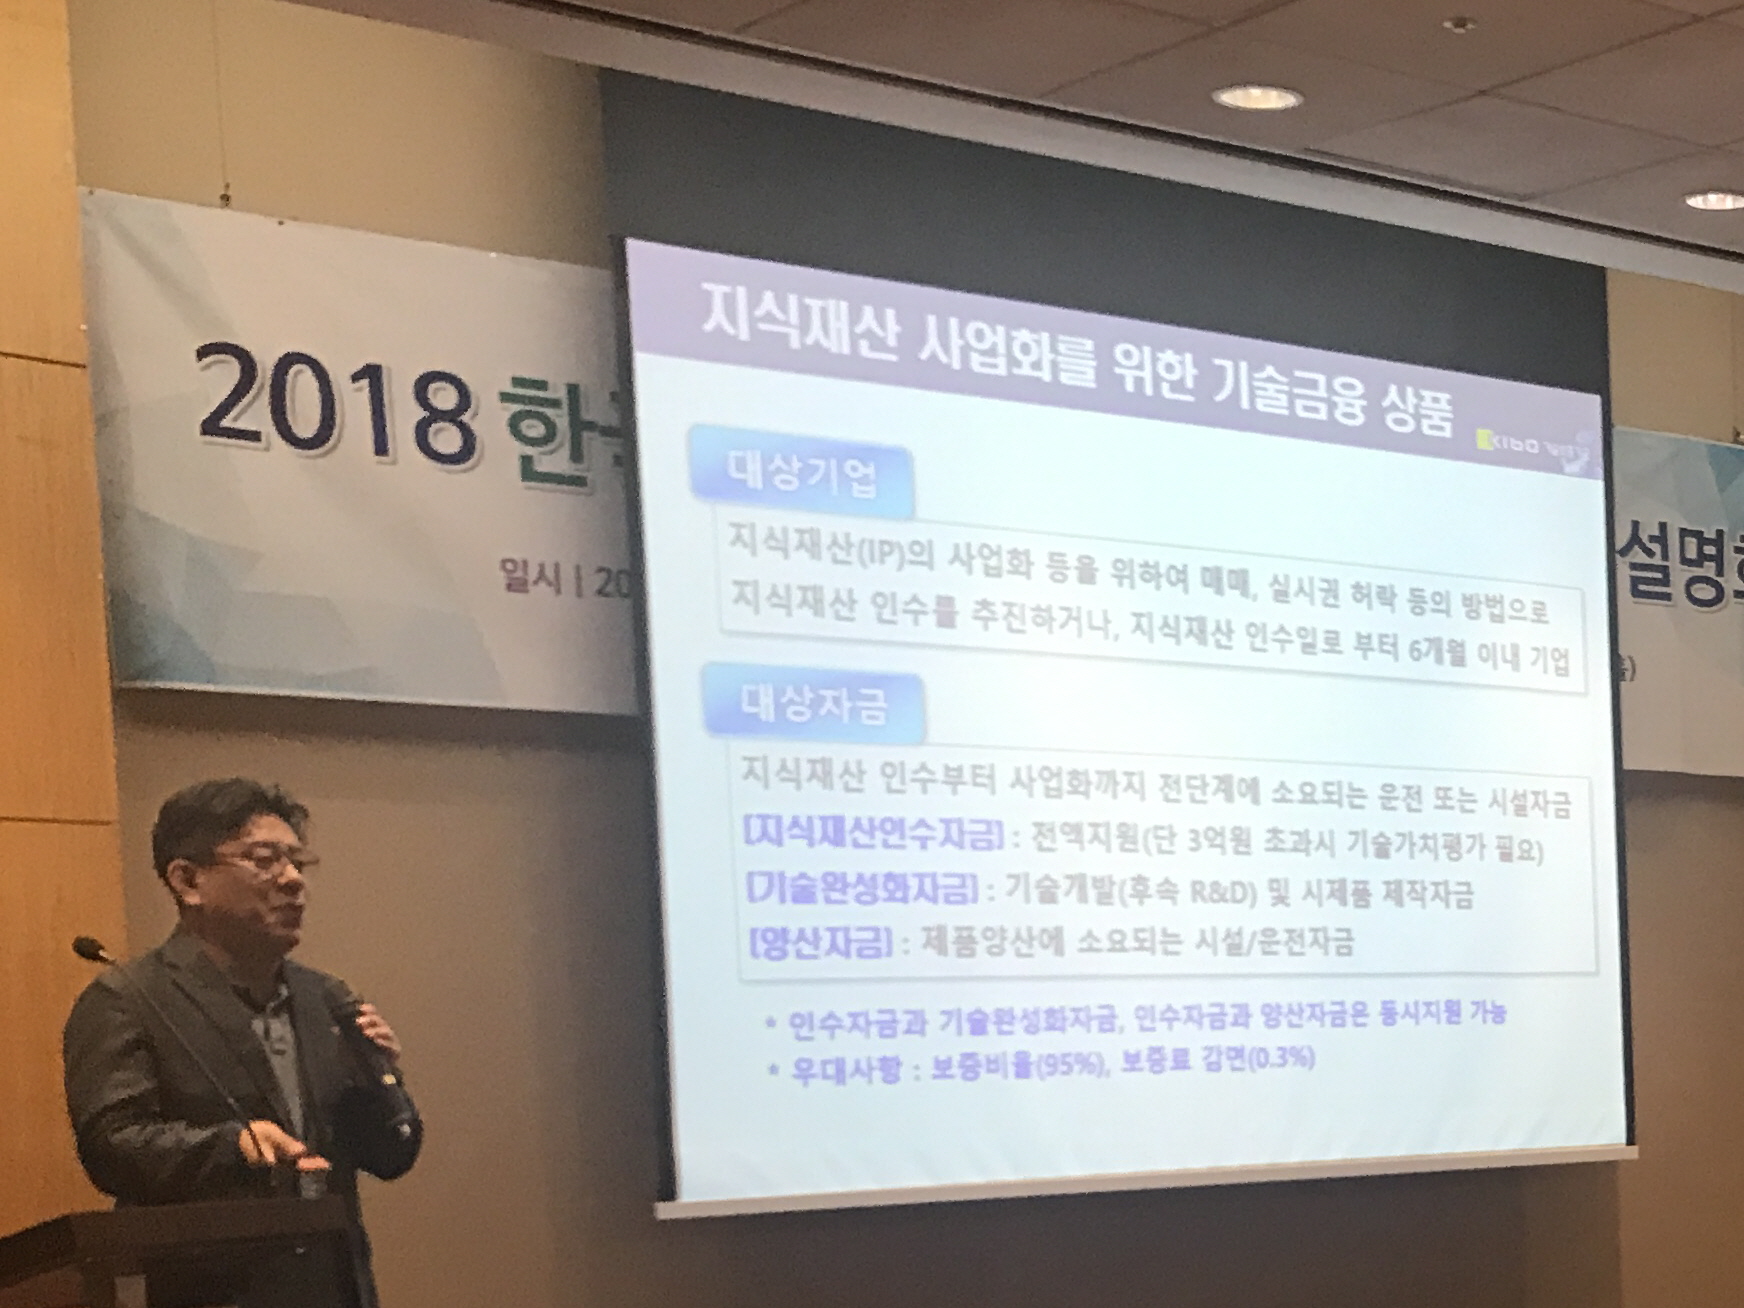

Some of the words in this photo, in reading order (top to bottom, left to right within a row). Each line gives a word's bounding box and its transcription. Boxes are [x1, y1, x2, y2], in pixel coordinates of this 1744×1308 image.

[701, 282, 900, 361] 지식재산
[919, 315, 1097, 388] 사업화를
[1113, 343, 1198, 401] 위한
[1213, 358, 1367, 427] 기술금융
[1381, 384, 1454, 439] 상품
[194, 342, 478, 466] 2018
[499, 376, 626, 487] 한
[726, 448, 877, 500] 대상기업
[499, 557, 562, 597] 일시
[728, 521, 935, 571] 지식재산(IP)의
[948, 542, 1034, 581] 사업화
[1046, 552, 1100, 586] 등을
[1110, 557, 1190, 595] 위하여
[1269, 573, 1340, 608] 실시권
[1350, 580, 1398, 614] 허락
[1407, 588, 1452, 618] 등의
[1461, 593, 1550, 625] 방법으로
[731, 579, 857, 623] 지식재산
[871, 590, 959, 630] 인수를
[971, 598, 1120, 643] 추진하거나,
[1130, 610, 1234, 651] 지식재산
[1246, 622, 1344, 656] 인수일로
[1353, 632, 1399, 662] 부터
[1408, 636, 1467, 669] 6개월
[1478, 643, 1521, 672] 이내
[1530, 647, 1570, 678] 기업
[740, 682, 887, 726] 대상자금
[741, 755, 866, 793] 지식재산
[880, 760, 997, 796] 인수부터
[1010, 763, 1147, 801] 사업화까지
[1159, 773, 1261, 806] 전단계에
[1271, 780, 1369, 810] 소요되는
[1378, 783, 1424, 814] 운전
[1433, 786, 1478, 815] 또는
[1488, 787, 1573, 820] 시설자금
[1031, 821, 1177, 857] 전액지원(단
[1188, 826, 1252, 855] 3억원
[1264, 827, 1336, 858] 초과시
[1348, 829, 1486, 862] 기술가치평가
[1495, 834, 1545, 866] 필요)
[1005, 871, 1180, 908] 기술개발(후속
[1191, 879, 1258, 908] R&D)
[1268, 877, 1291, 908] 및
[1302, 877, 1372, 910] 시제품
[1381, 879, 1475, 910] 제작자금
[921, 924, 1065, 959] 제품양산에
[1077, 926, 1184, 957] 소요되는
[1195, 926, 1355, 957] 시설/운전자금
[789, 1009, 927, 1041] 인수자금과
[1134, 1003, 1253, 1033] 인수자금과
[1260, 1000, 1369, 1030] 양산자금은
[1379, 1000, 1463, 1026] 동시지원
[1470, 1000, 1507, 1026] 가능
[792, 1055, 902, 1087] 우대사항
[1121, 1046, 1192, 1075] 보증료
